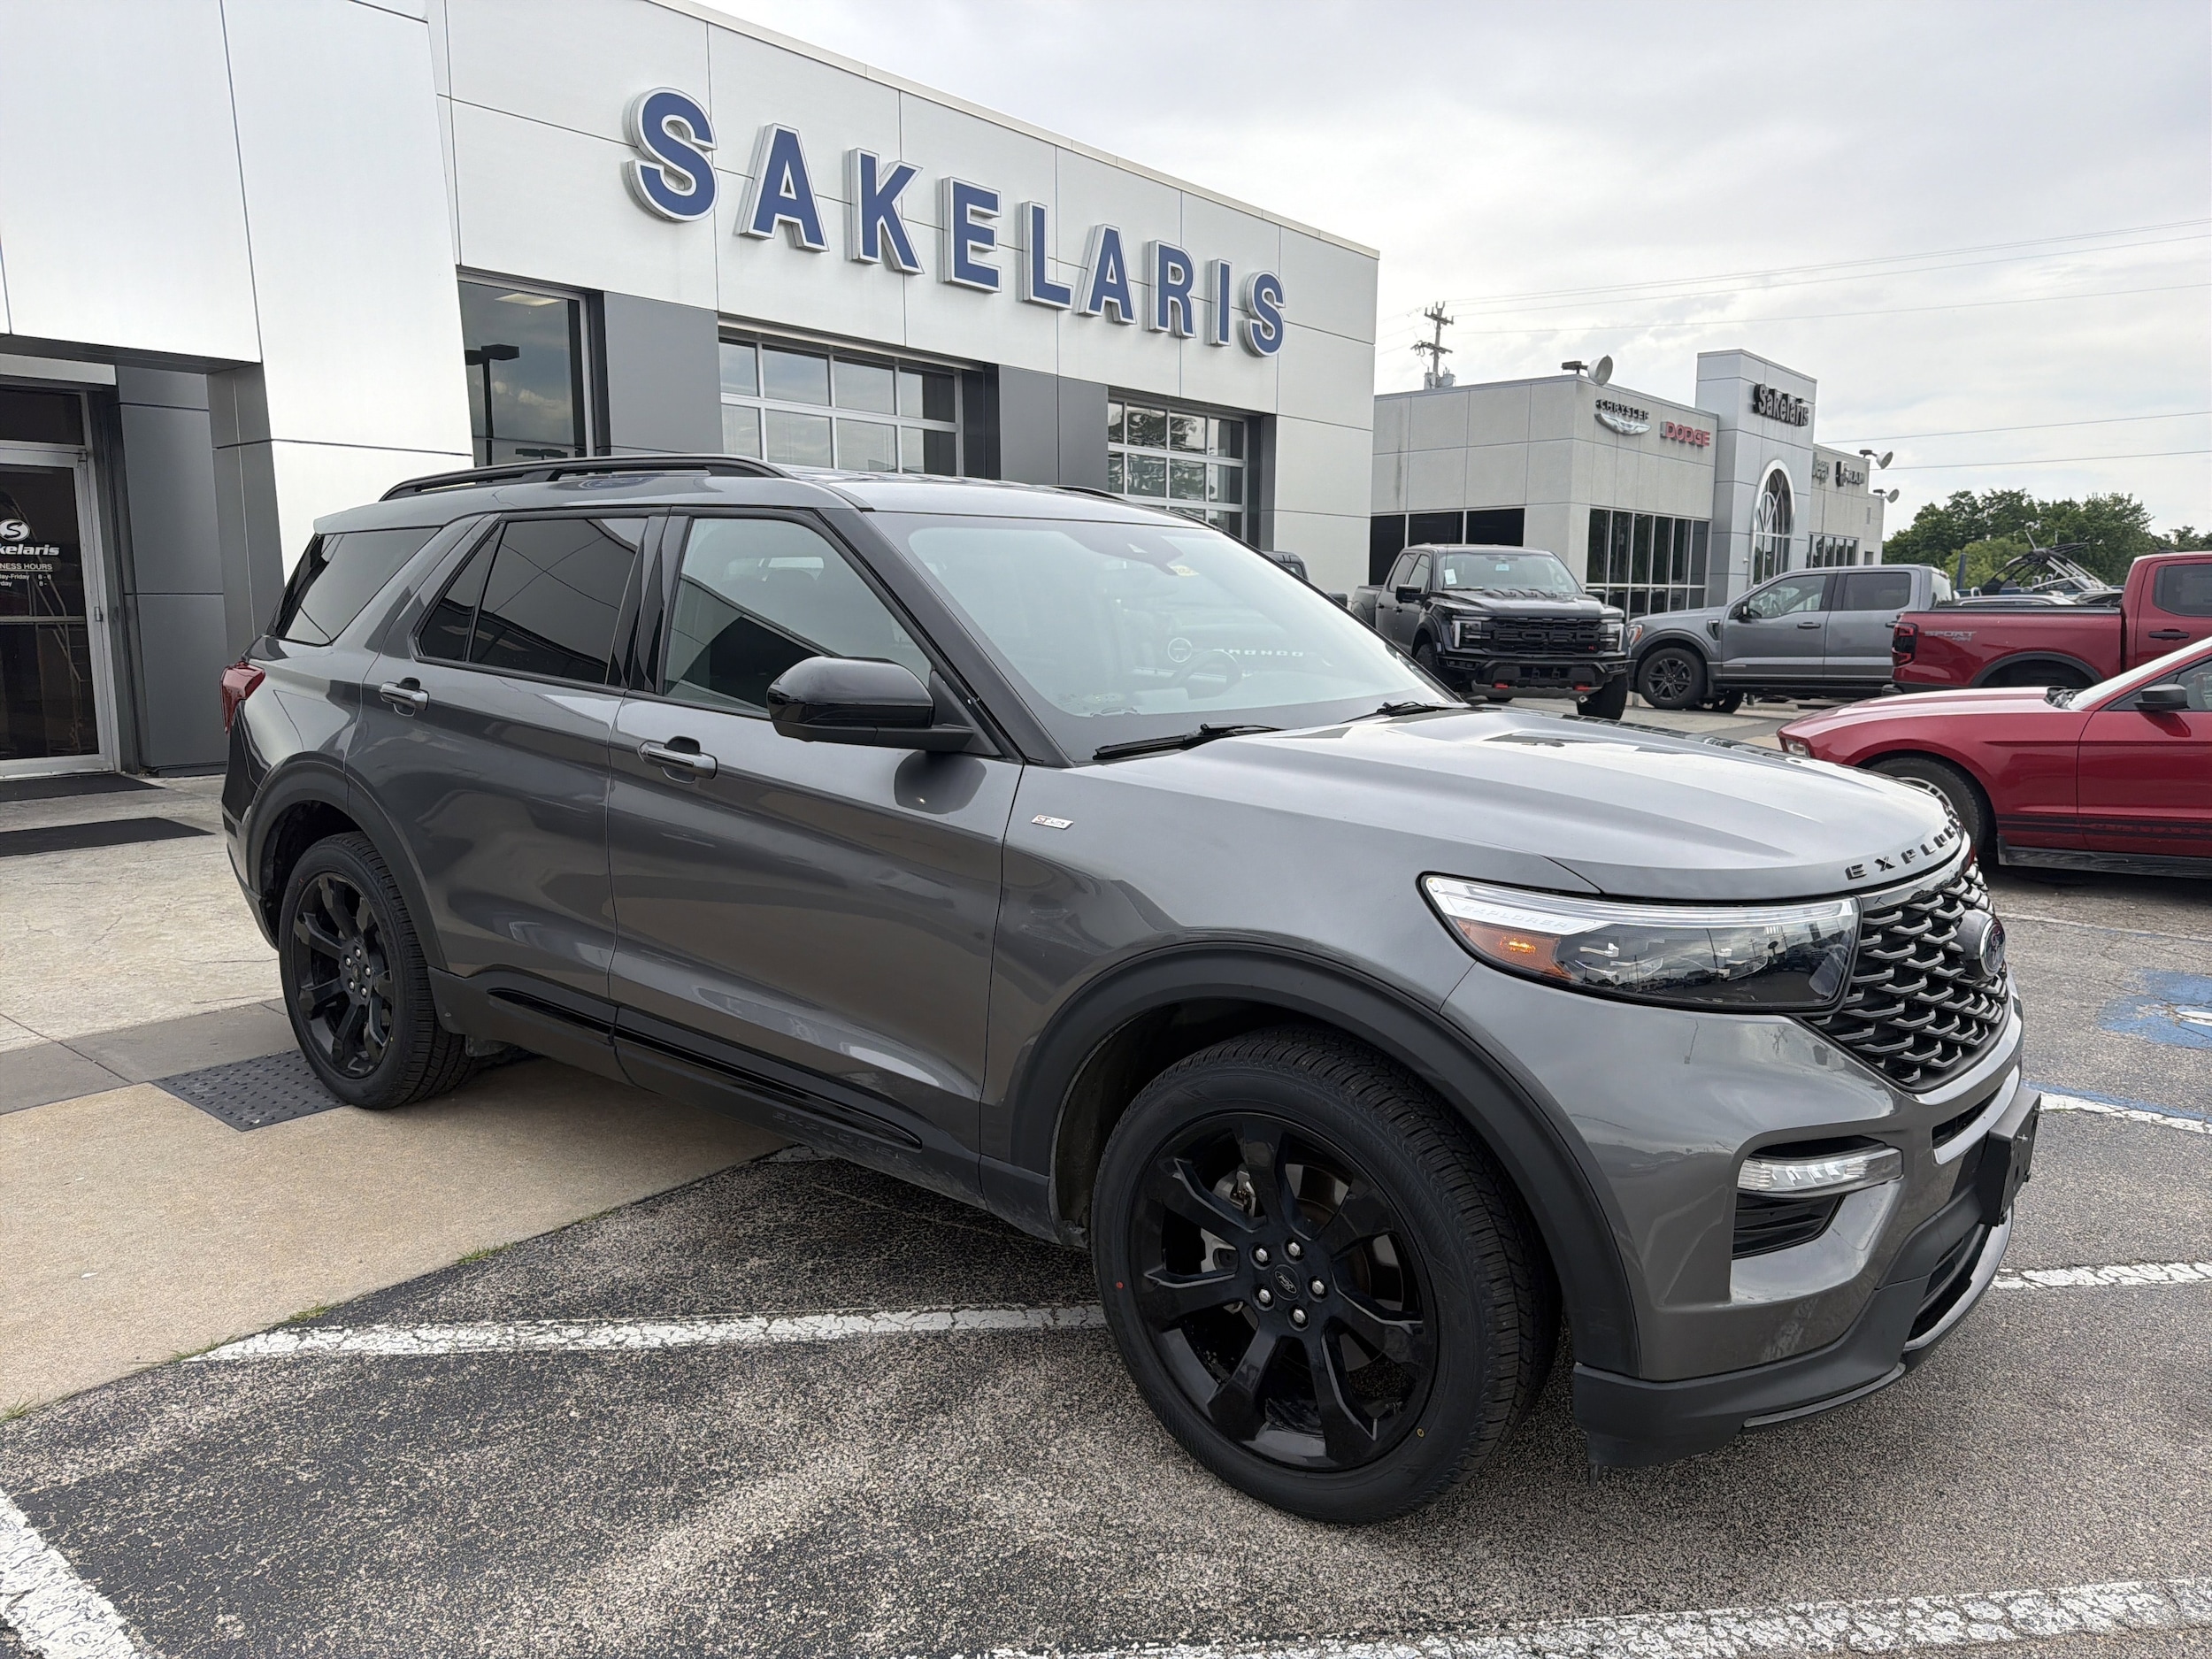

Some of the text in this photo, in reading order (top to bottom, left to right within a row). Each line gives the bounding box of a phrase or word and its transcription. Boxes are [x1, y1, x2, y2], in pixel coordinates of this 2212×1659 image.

[626, 87, 1286, 357] SAKELARIS
[1754, 384, 1809, 426] Sakelaris
[1661, 421, 1710, 447] DODGE
[1493, 629, 1600, 643] FORD
[1212, 648, 1304, 657] RONCO
[1461, 904, 1568, 928] EXPLORER
